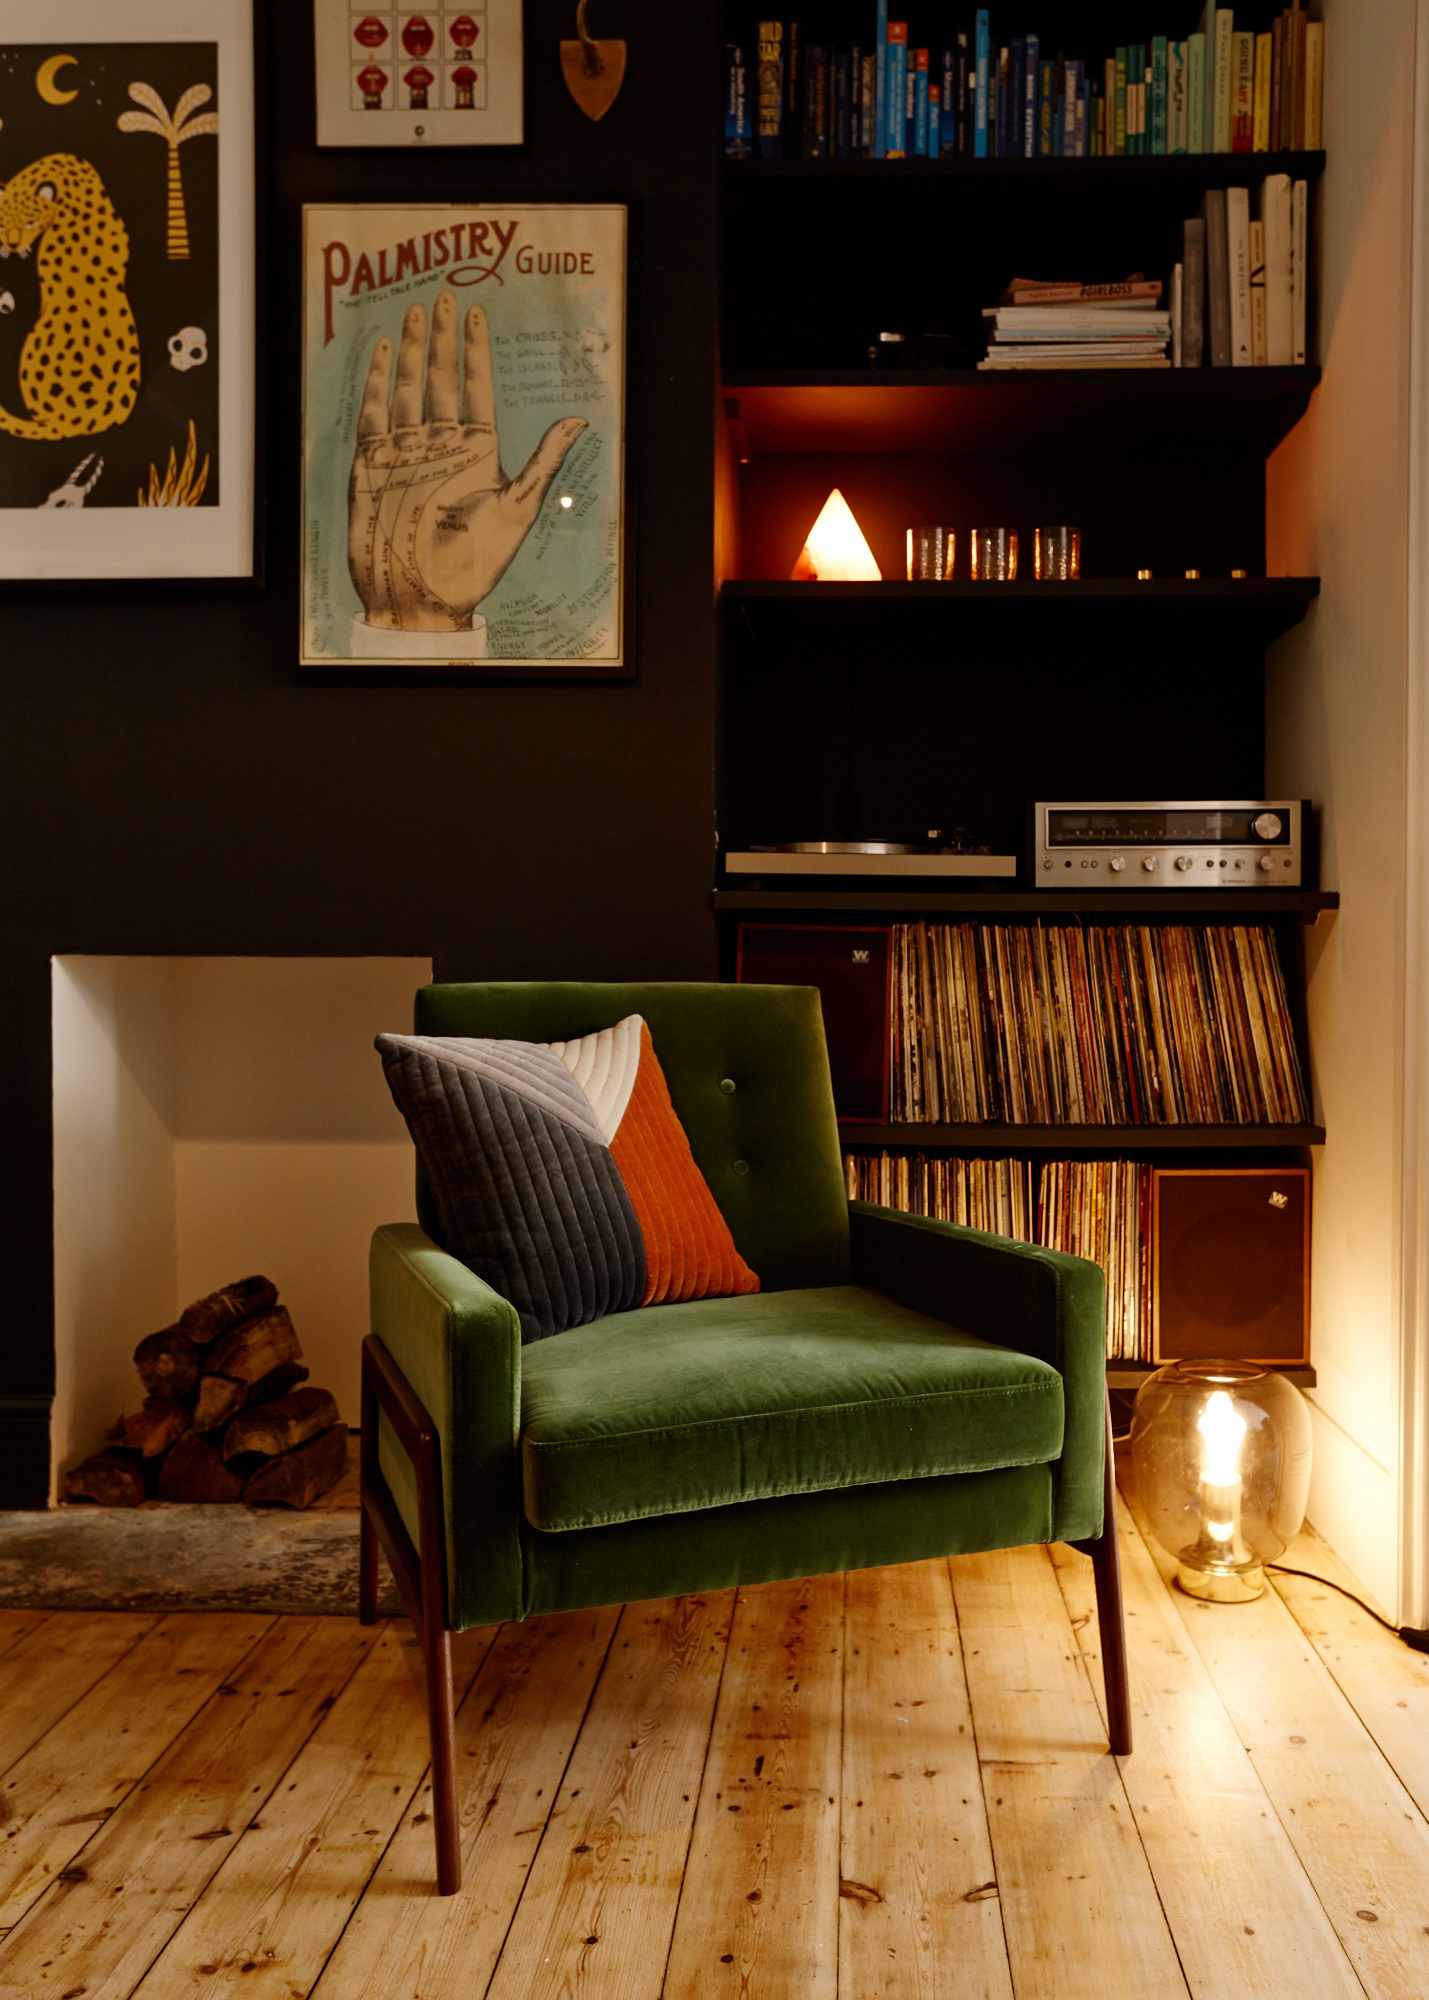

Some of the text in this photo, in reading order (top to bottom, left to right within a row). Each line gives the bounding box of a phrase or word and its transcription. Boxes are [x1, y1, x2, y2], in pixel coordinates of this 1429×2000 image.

[1238, 38, 1249, 74] GOING
[736, 66, 746, 134] South America
[906, 72, 916, 119] Barcelona
[942, 70, 954, 112] Morocco
[1026, 74, 1034, 100] BOOK
[1238, 75, 1250, 104] EAST
[321, 220, 595, 348] PALMISTRY GUIDE
[366, 292, 388, 304] TELL
[390, 282, 412, 296] TALE
[1080, 284, 1133, 297] #GIRLBOSS
[389, 478, 408, 488] LINE
[432, 469, 448, 478] THE
[453, 453, 480, 470] HEAD
[410, 506, 422, 525] LIFE
[576, 494, 599, 518] WILL
[435, 521, 469, 532] VENUS
[400, 570, 429, 598] HEALTH
[500, 592, 539, 611] AVERSION
[564, 626, 610, 658] INTEGRITY
